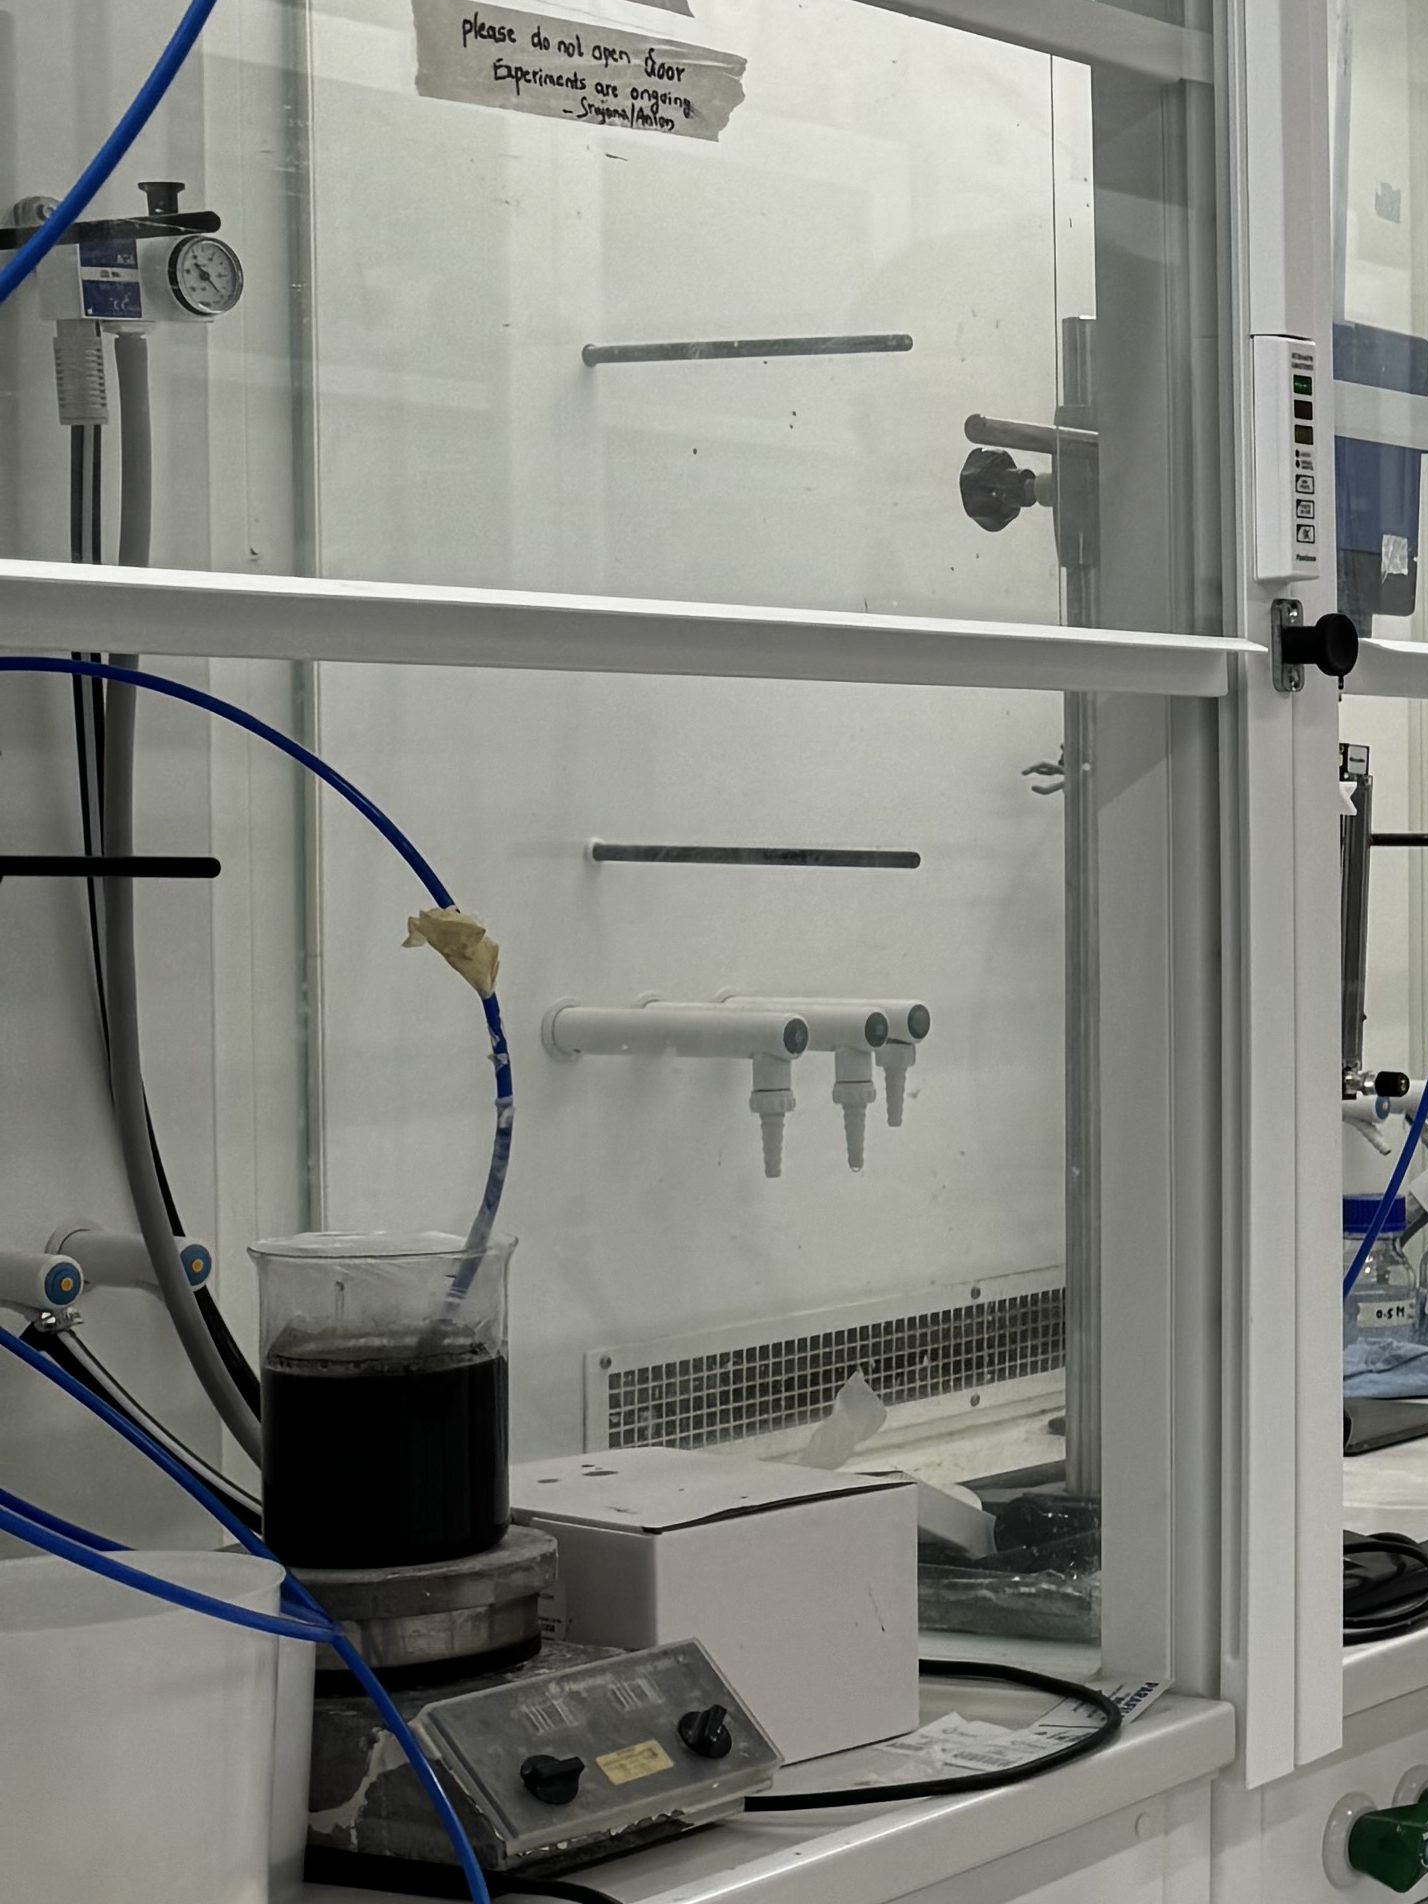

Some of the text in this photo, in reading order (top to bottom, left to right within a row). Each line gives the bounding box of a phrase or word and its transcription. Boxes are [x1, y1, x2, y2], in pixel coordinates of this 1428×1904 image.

[461, 11, 686, 82] please do not open door
[493, 58, 694, 118] Experiments are ongoing
